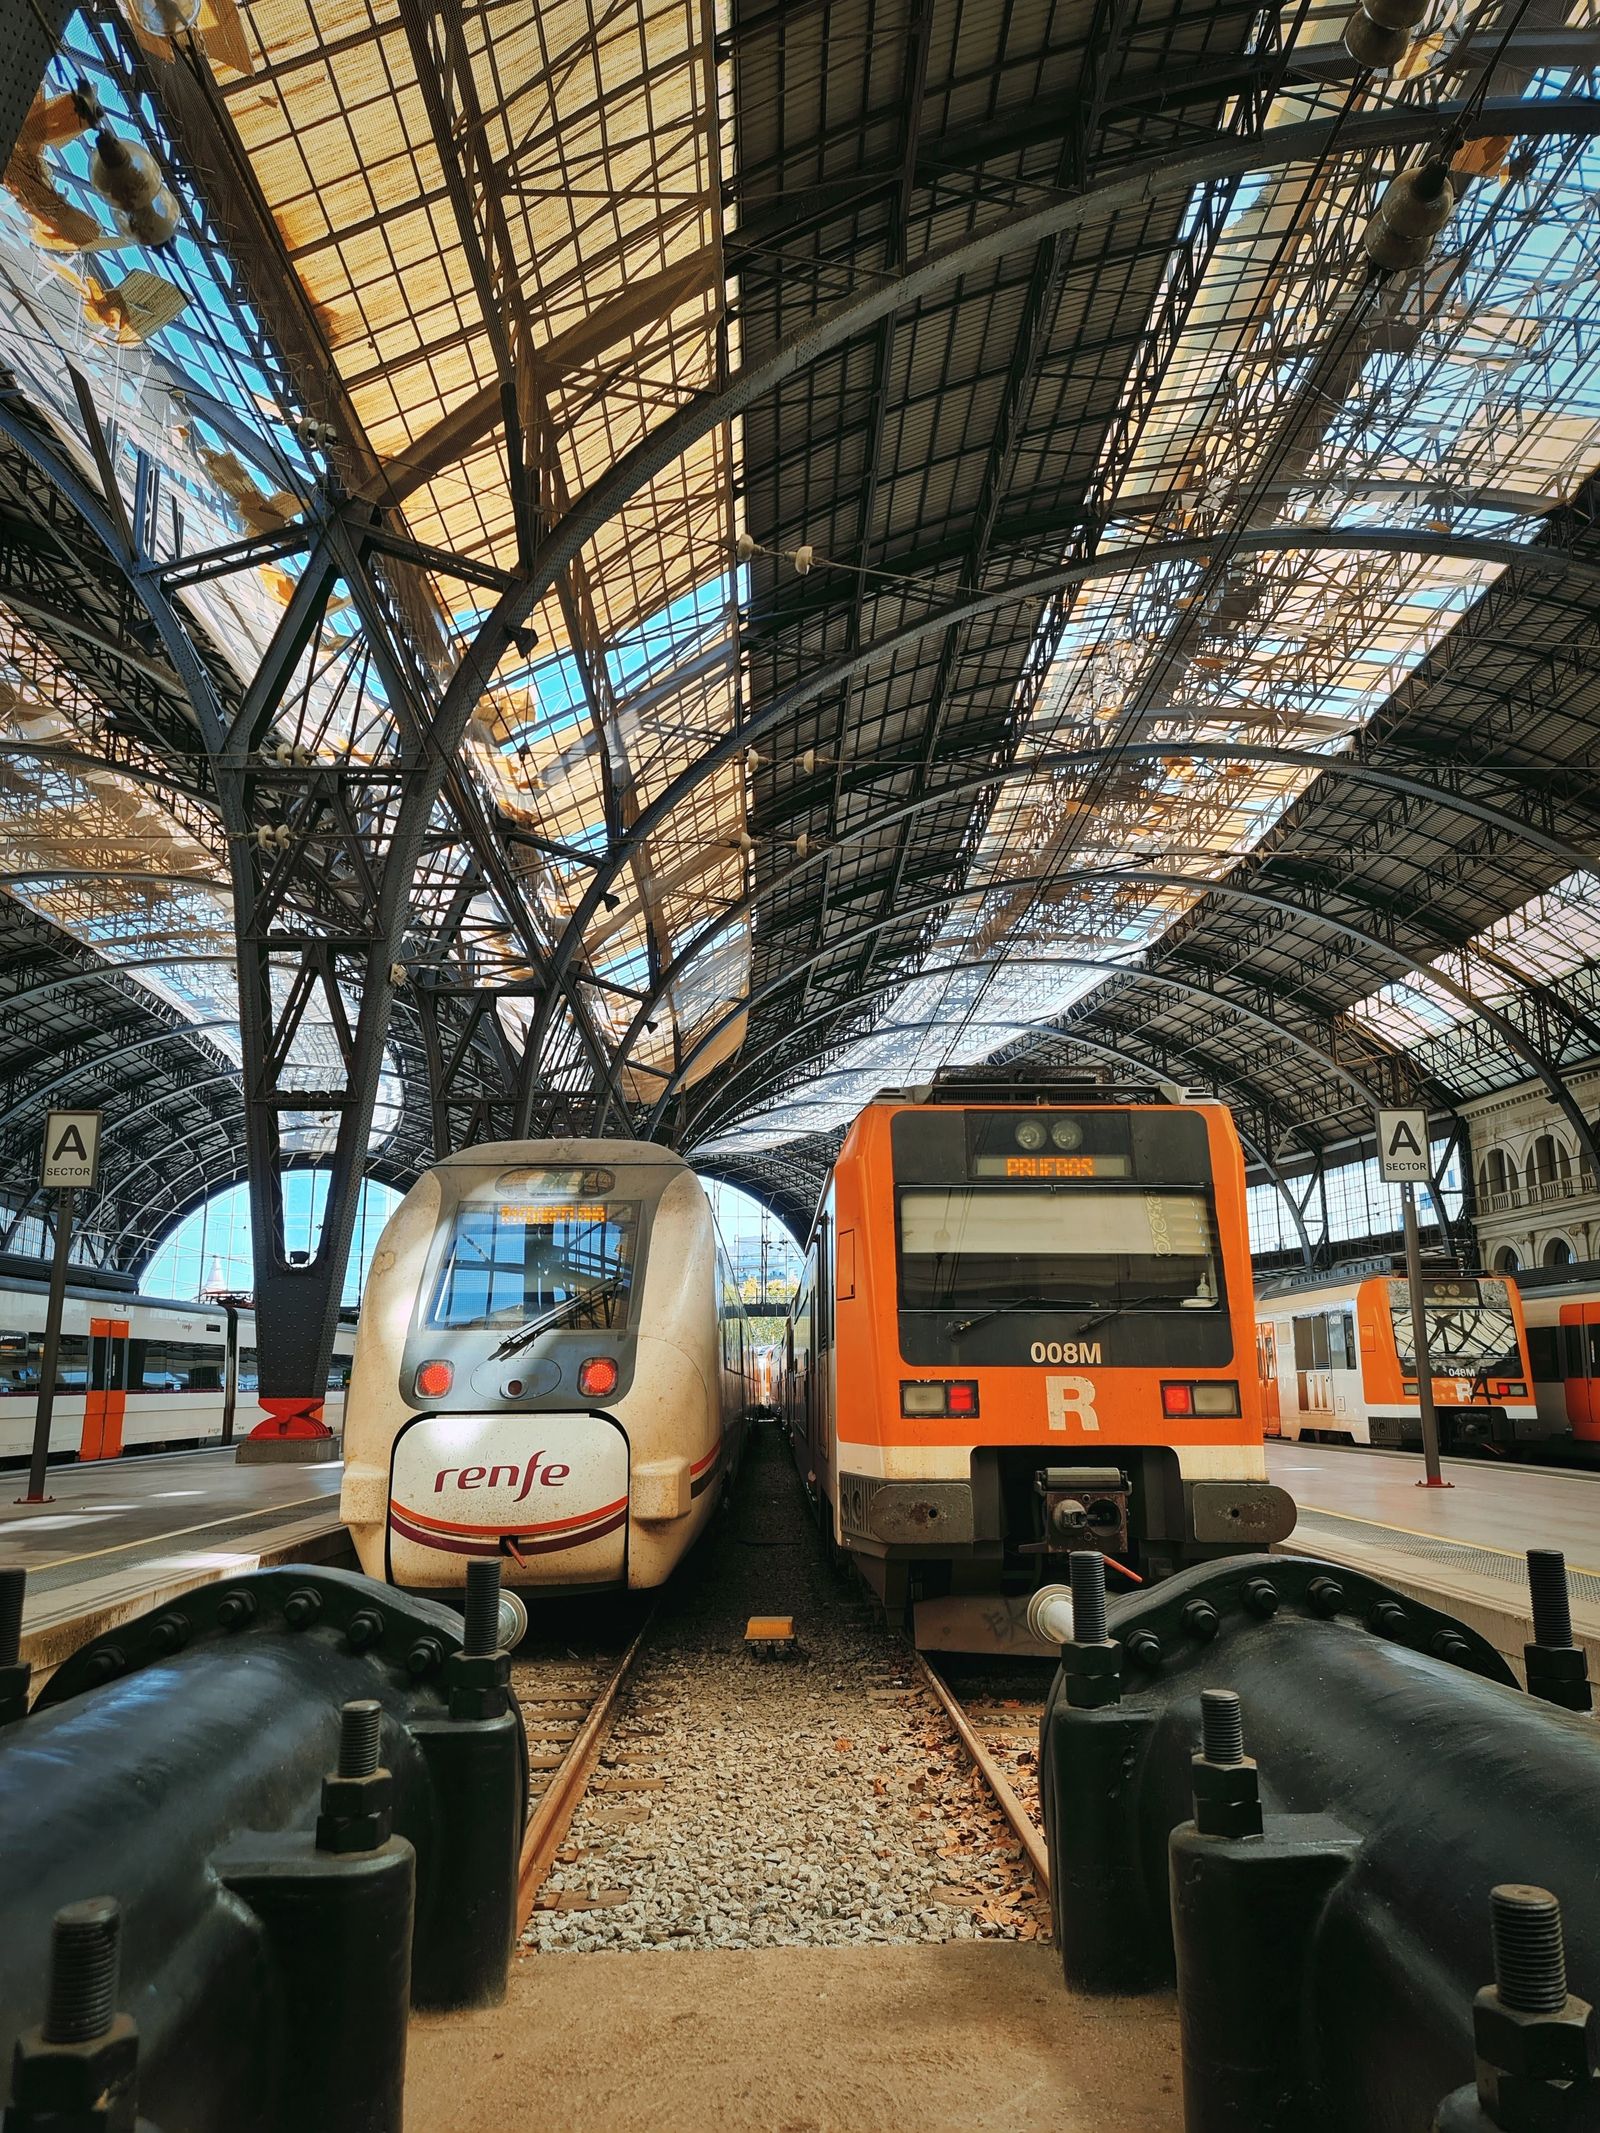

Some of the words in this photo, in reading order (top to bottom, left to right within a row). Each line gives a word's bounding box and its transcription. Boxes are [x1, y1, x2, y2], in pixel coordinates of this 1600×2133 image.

[52, 1124, 87, 1161] A
[1388, 1120, 1422, 1157] A
[46, 1167, 91, 1177] SECTOR
[1385, 1162, 1427, 1171] SECTOR
[1030, 1341, 1102, 1364] 008M
[1448, 1367, 1476, 1377] 048M
[1045, 1375, 1100, 1431] R
[434, 1450, 571, 1503] renfe
